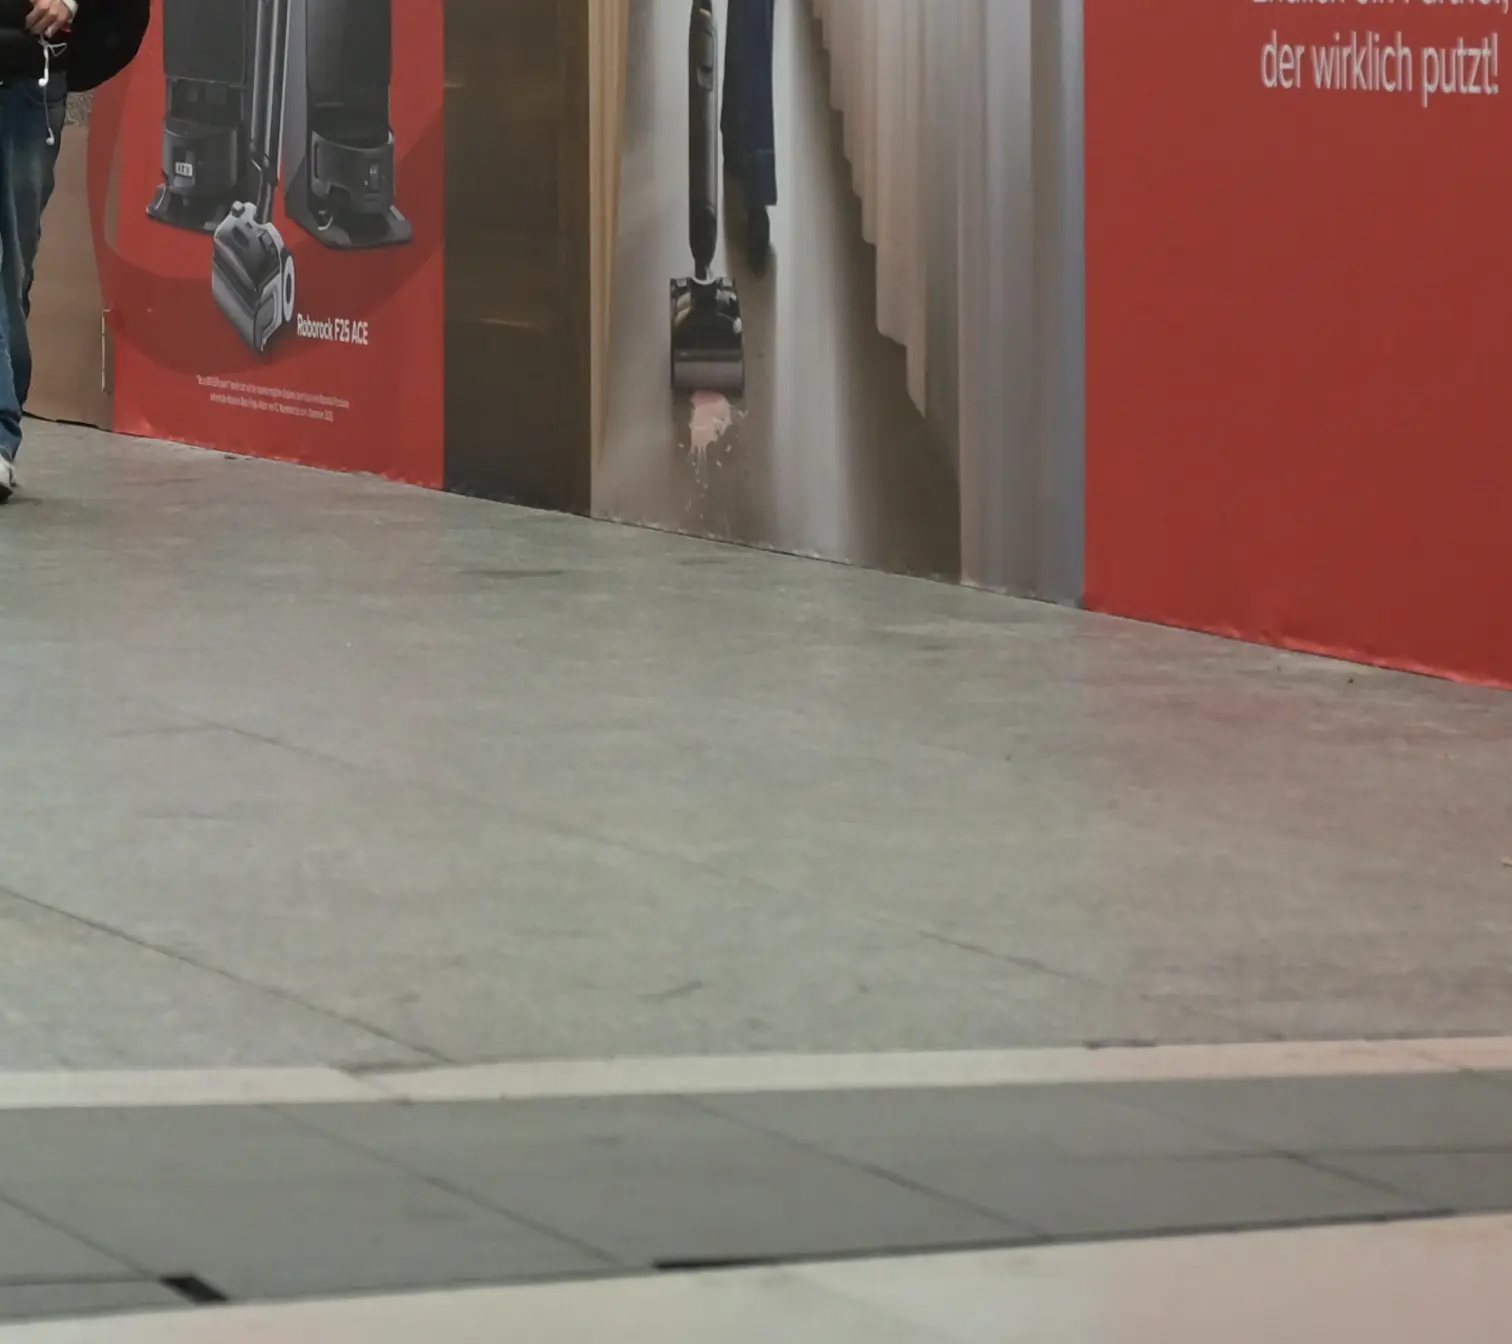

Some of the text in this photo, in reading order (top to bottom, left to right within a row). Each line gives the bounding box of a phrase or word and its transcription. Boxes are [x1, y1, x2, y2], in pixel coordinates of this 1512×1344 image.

[1260, 29, 1500, 109] der wirklich putzt!
[297, 312, 369, 346] Roborock F25 ACE
